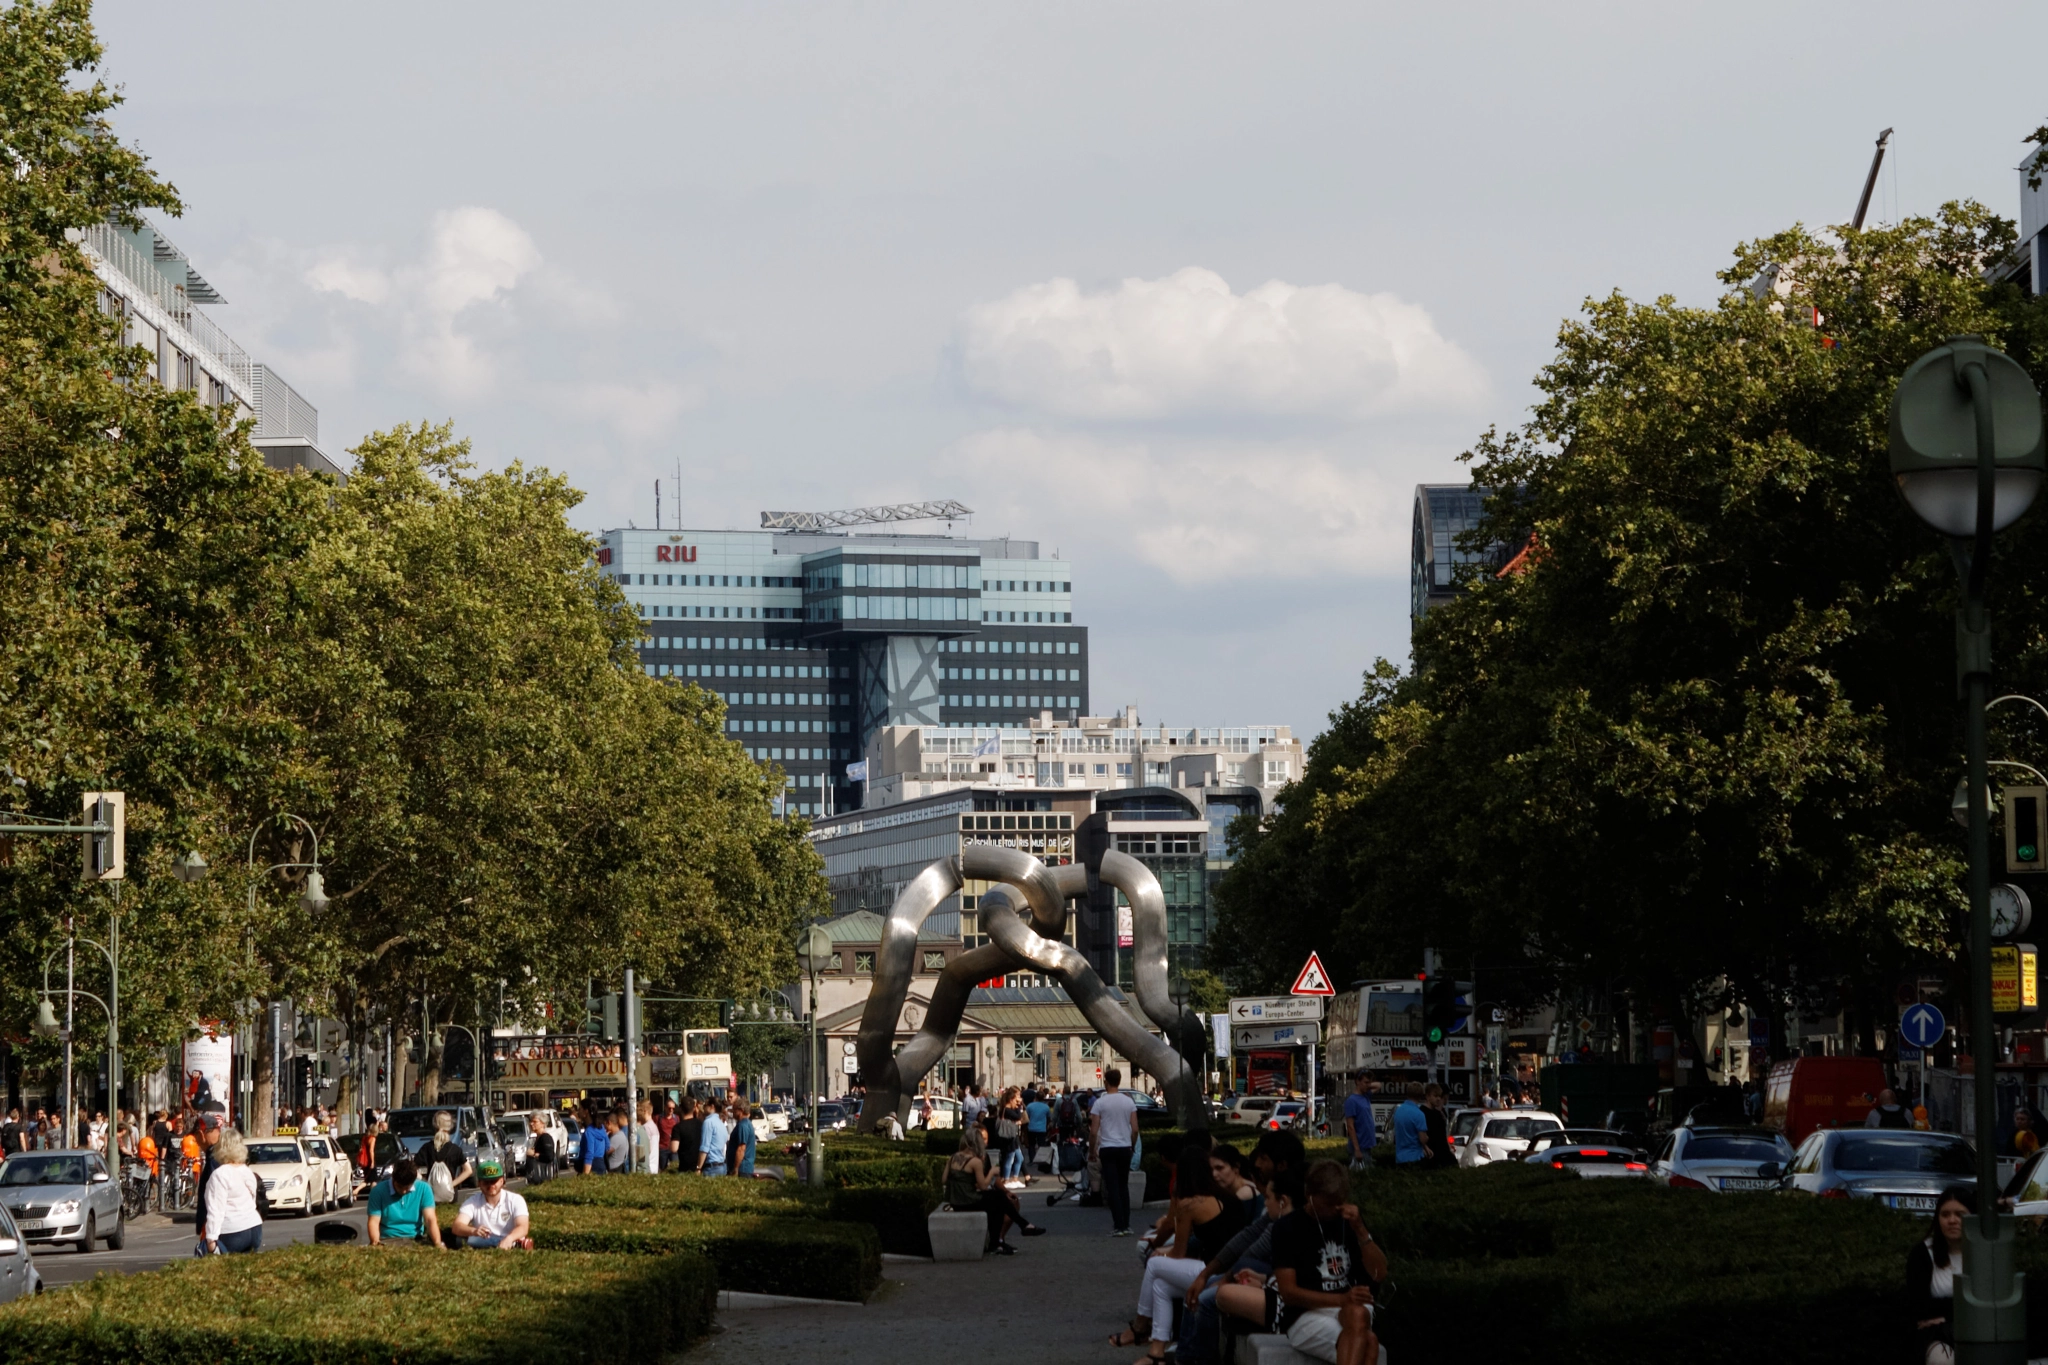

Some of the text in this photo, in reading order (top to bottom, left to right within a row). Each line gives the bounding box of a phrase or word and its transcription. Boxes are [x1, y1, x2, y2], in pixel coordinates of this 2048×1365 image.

[657, 545, 696, 562] RIU
[1010, 980, 1062, 988] BERL
[1265, 1010, 1305, 1018] Europa-Center
[536, 1060, 577, 1076] CITY
